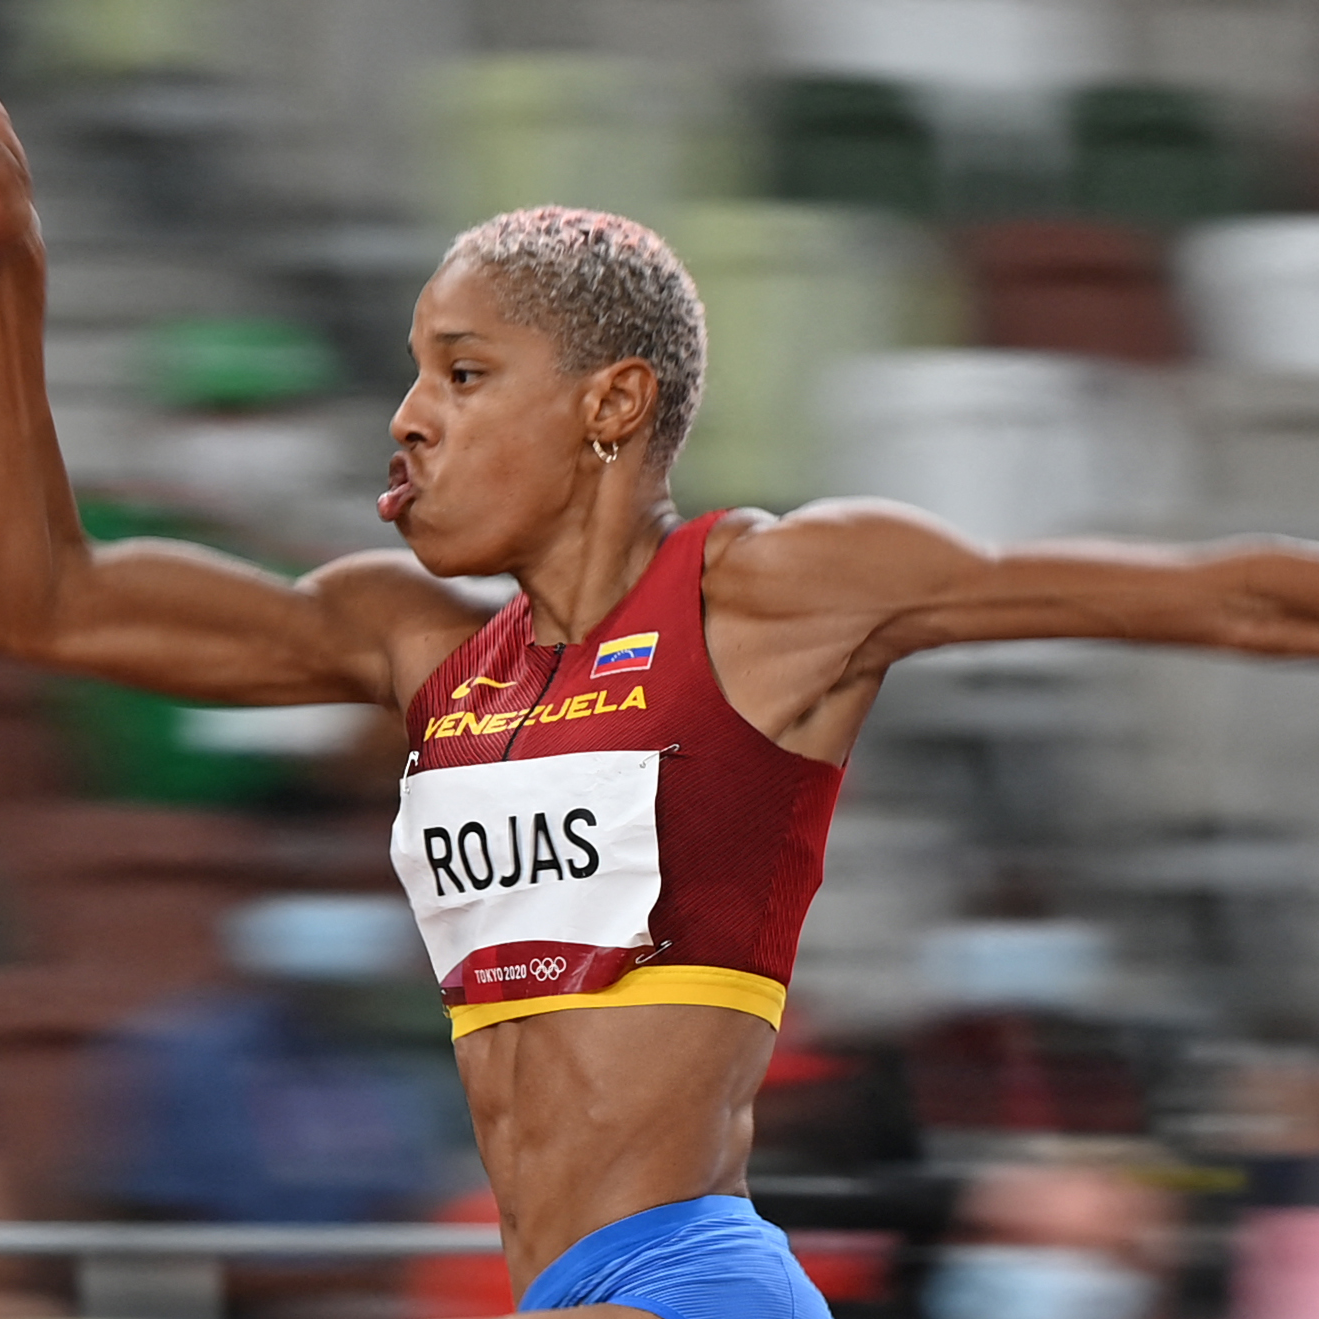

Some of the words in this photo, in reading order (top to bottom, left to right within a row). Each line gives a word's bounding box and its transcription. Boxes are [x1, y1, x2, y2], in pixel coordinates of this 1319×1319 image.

[423, 685, 647, 742] VENEZUELA
[423, 808, 600, 897] ROJAS
[474, 967, 503, 984] TOKYO
[504, 964, 527, 981] 2020
